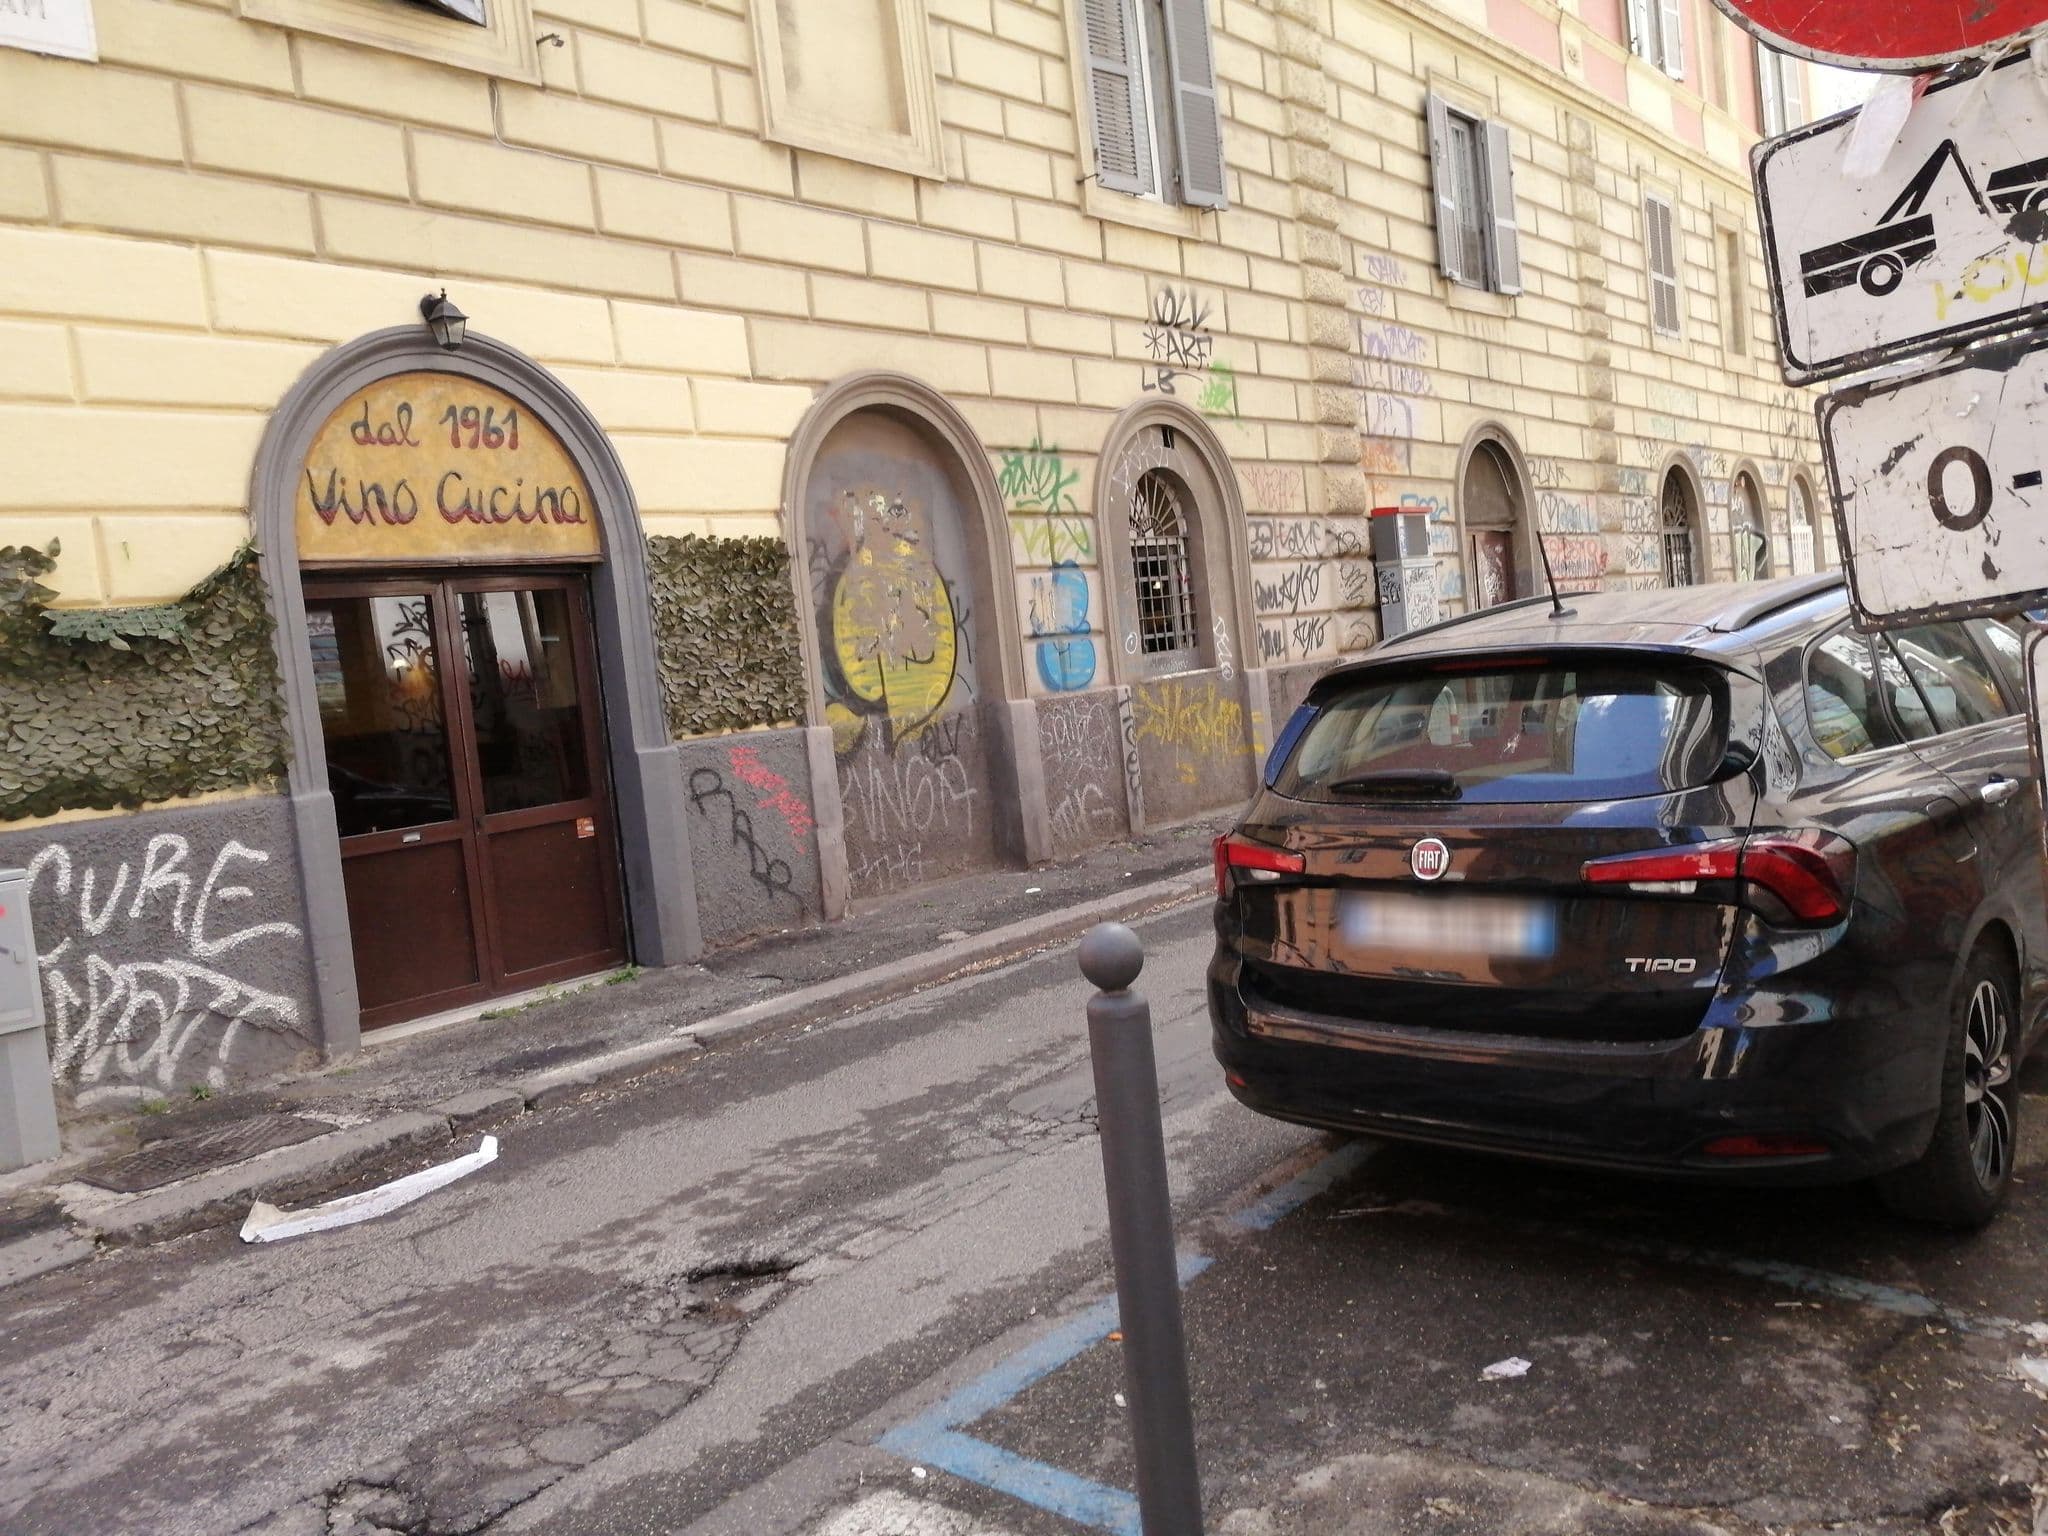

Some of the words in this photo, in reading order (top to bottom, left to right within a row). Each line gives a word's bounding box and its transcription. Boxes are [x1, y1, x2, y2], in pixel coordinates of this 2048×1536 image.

[350, 401, 420, 446] dal
[439, 404, 519, 450] 1961
[306, 467, 418, 526] Vino
[437, 472, 587, 525] Cucina
[1419, 850, 1441, 870] FIAT
[1624, 957, 1697, 973] TIPO
